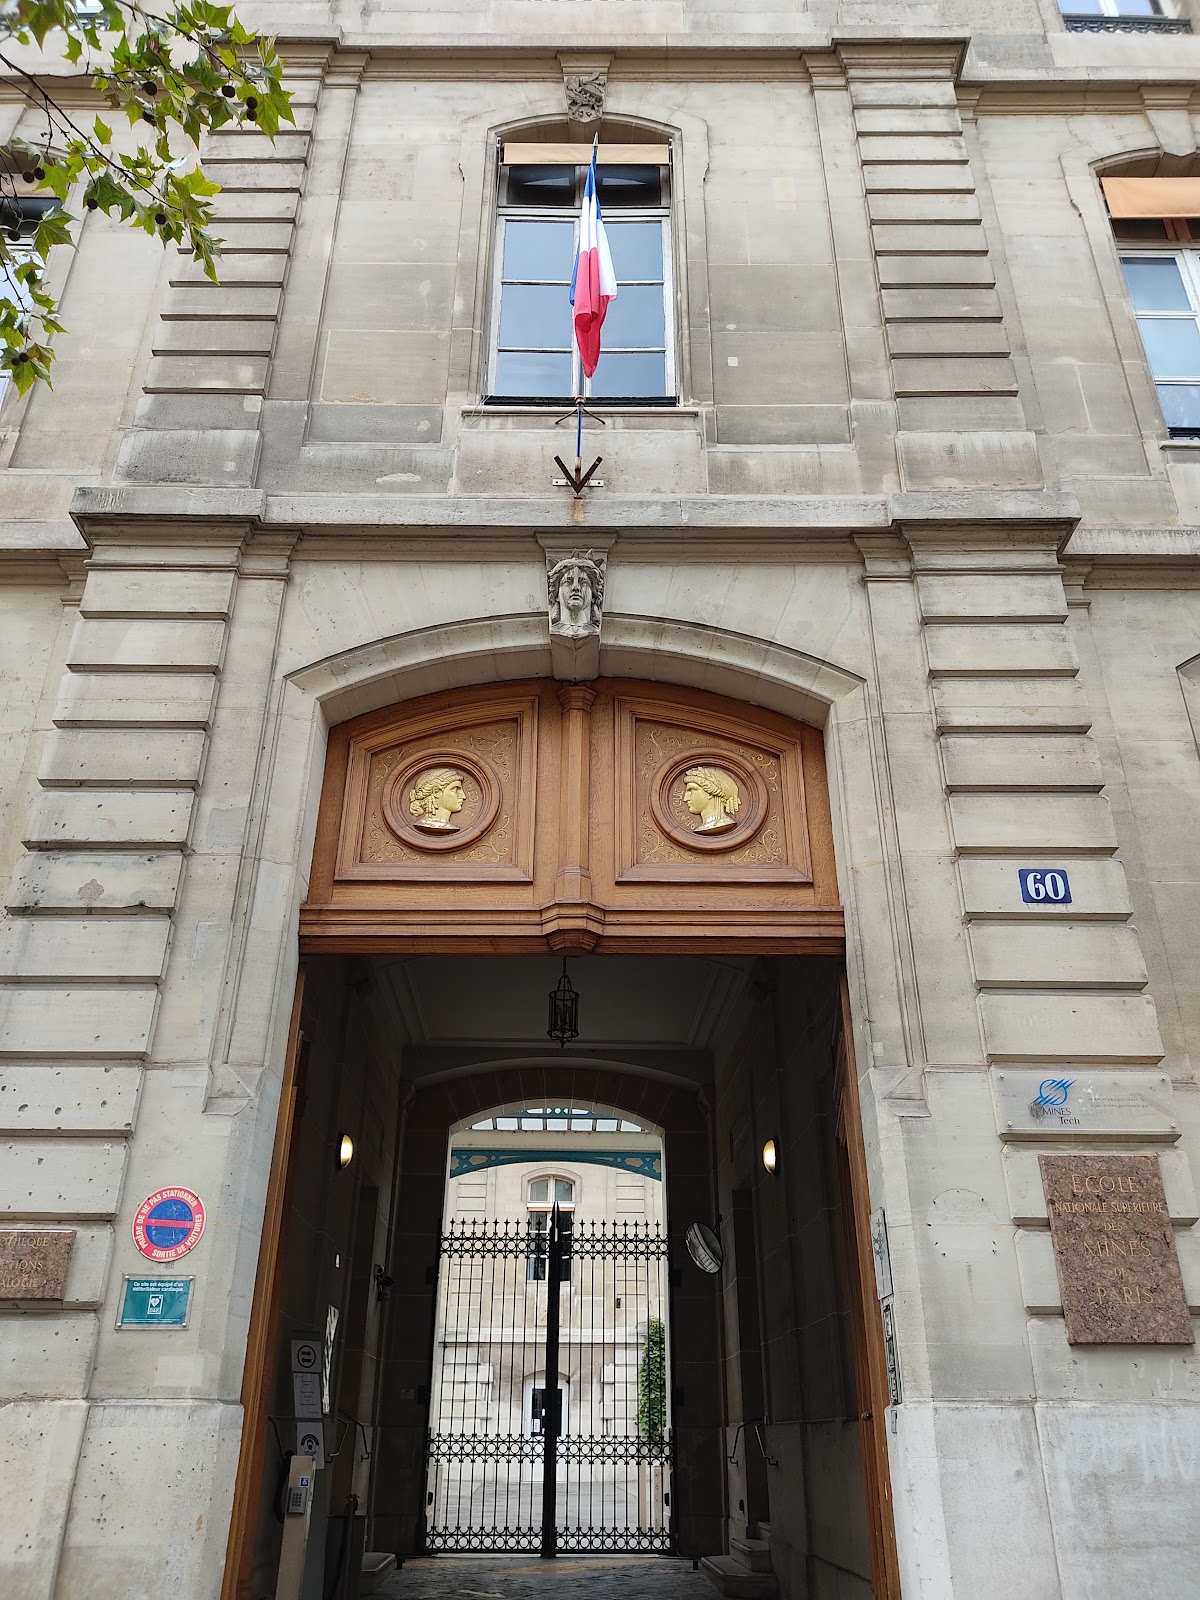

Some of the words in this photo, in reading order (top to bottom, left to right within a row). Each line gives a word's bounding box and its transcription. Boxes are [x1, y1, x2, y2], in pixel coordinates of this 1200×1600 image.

[1026, 872, 1065, 900] 60
[1043, 1107, 1072, 1115] MINES
[149, 1193, 162, 1206] PAS
[162, 1189, 198, 1208] STATIONNER
[141, 1204, 151, 1214] NE
[1055, 1202, 1109, 1213] NATIONALE
[1111, 1202, 1165, 1213] SUPERIEURE
[136, 1214, 145, 1224] DE
[1103, 1222, 1123, 1231] DES
[136, 1225, 148, 1249] PRIÈRE
[151, 1249, 176, 1258] SORTIE
[176, 1244, 187, 1254] DE
[184, 1213, 202, 1246] VOITURES
[1082, 1240, 1151, 1257] MINES
[1097, 1286, 1154, 1304] PARIS
